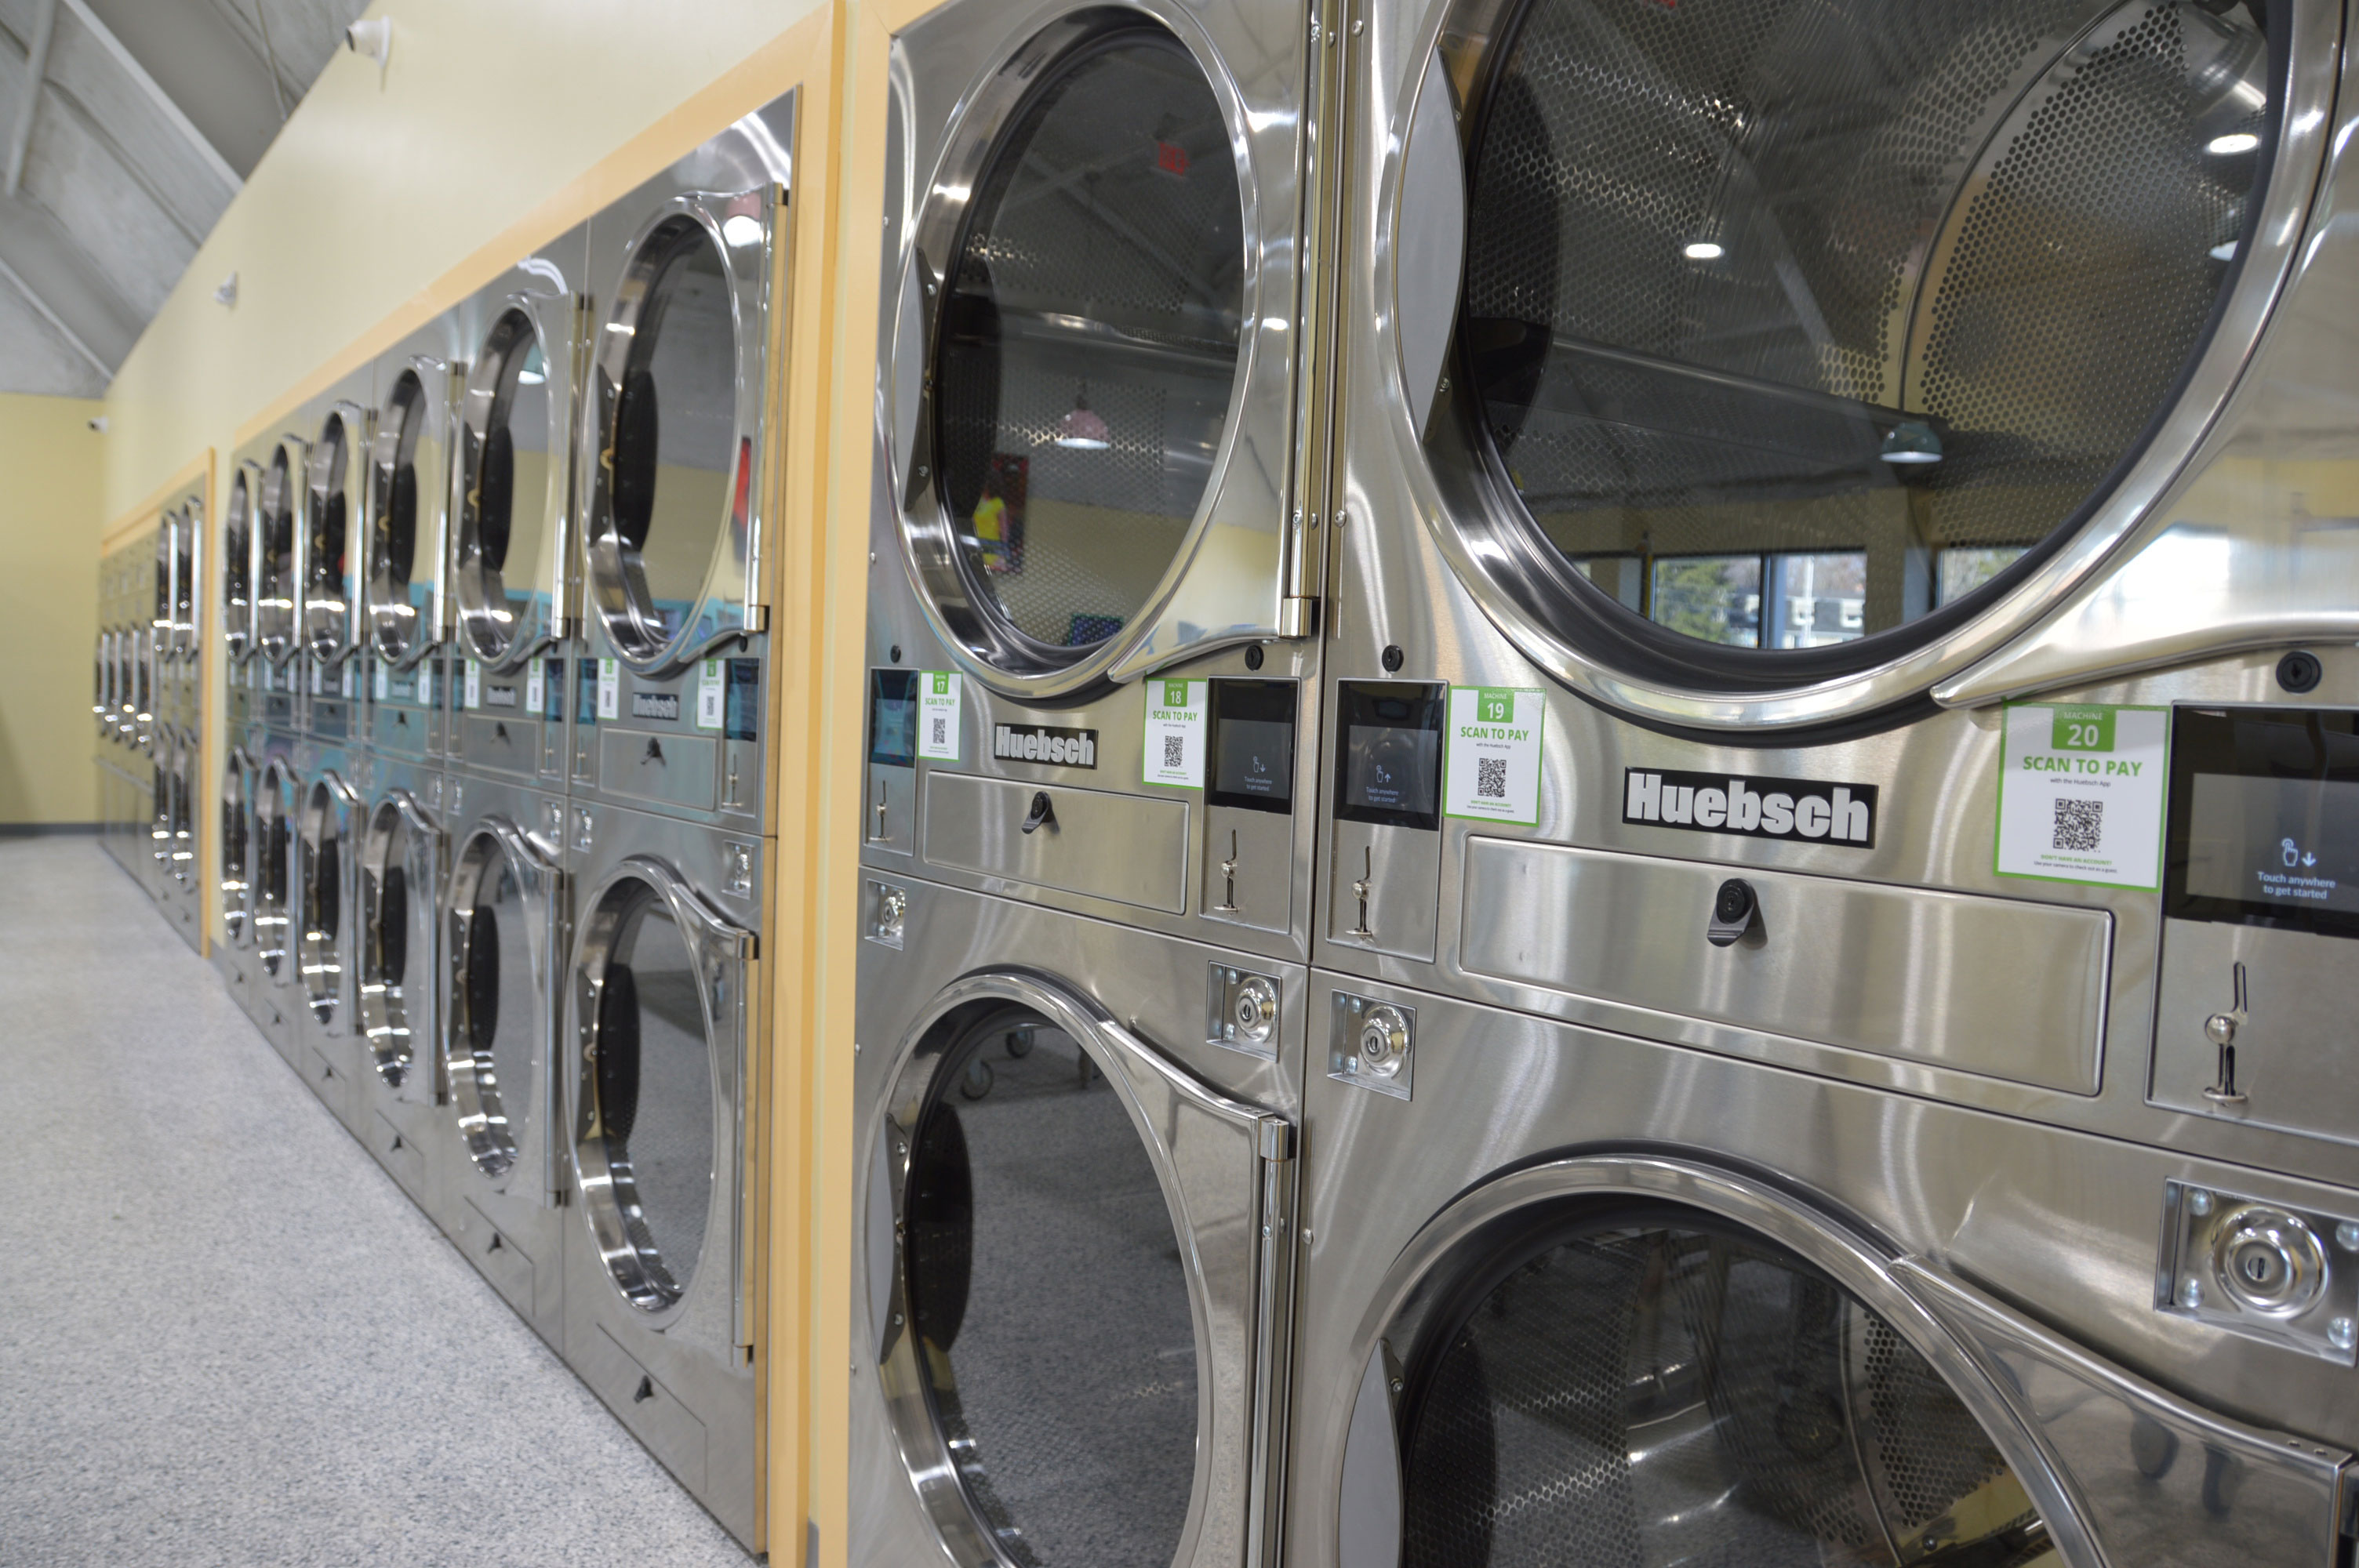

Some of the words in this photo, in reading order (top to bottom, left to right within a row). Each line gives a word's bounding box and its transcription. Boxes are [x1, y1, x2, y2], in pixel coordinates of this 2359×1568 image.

[937, 681, 945, 692] 17
[939, 698, 945, 706] TO
[1170, 691, 1181, 704] 18
[1153, 710, 1171, 720] SCAN
[1173, 711, 1182, 720] TO
[1183, 712, 1198, 721] PAY
[1487, 702, 1504, 719] 19
[2064, 712, 2103, 720] MACHINE
[1460, 726, 1488, 739] SCAN
[1492, 728, 1505, 739] TO
[1508, 729, 1528, 741] PAY
[2067, 724, 2099, 747] 20
[995, 726, 1094, 765] Huebsch
[2023, 756, 2071, 772] SCAN
[2076, 759, 2100, 774] TO
[2106, 760, 2143, 776] PAY
[1627, 771, 1869, 841] Huebsch
[2257, 871, 2287, 883] Touch
[2288, 877, 2336, 888] anywhere
[2263, 884, 2274, 894] to
[2275, 887, 2291, 897] get
[2293, 888, 2328, 899] started
